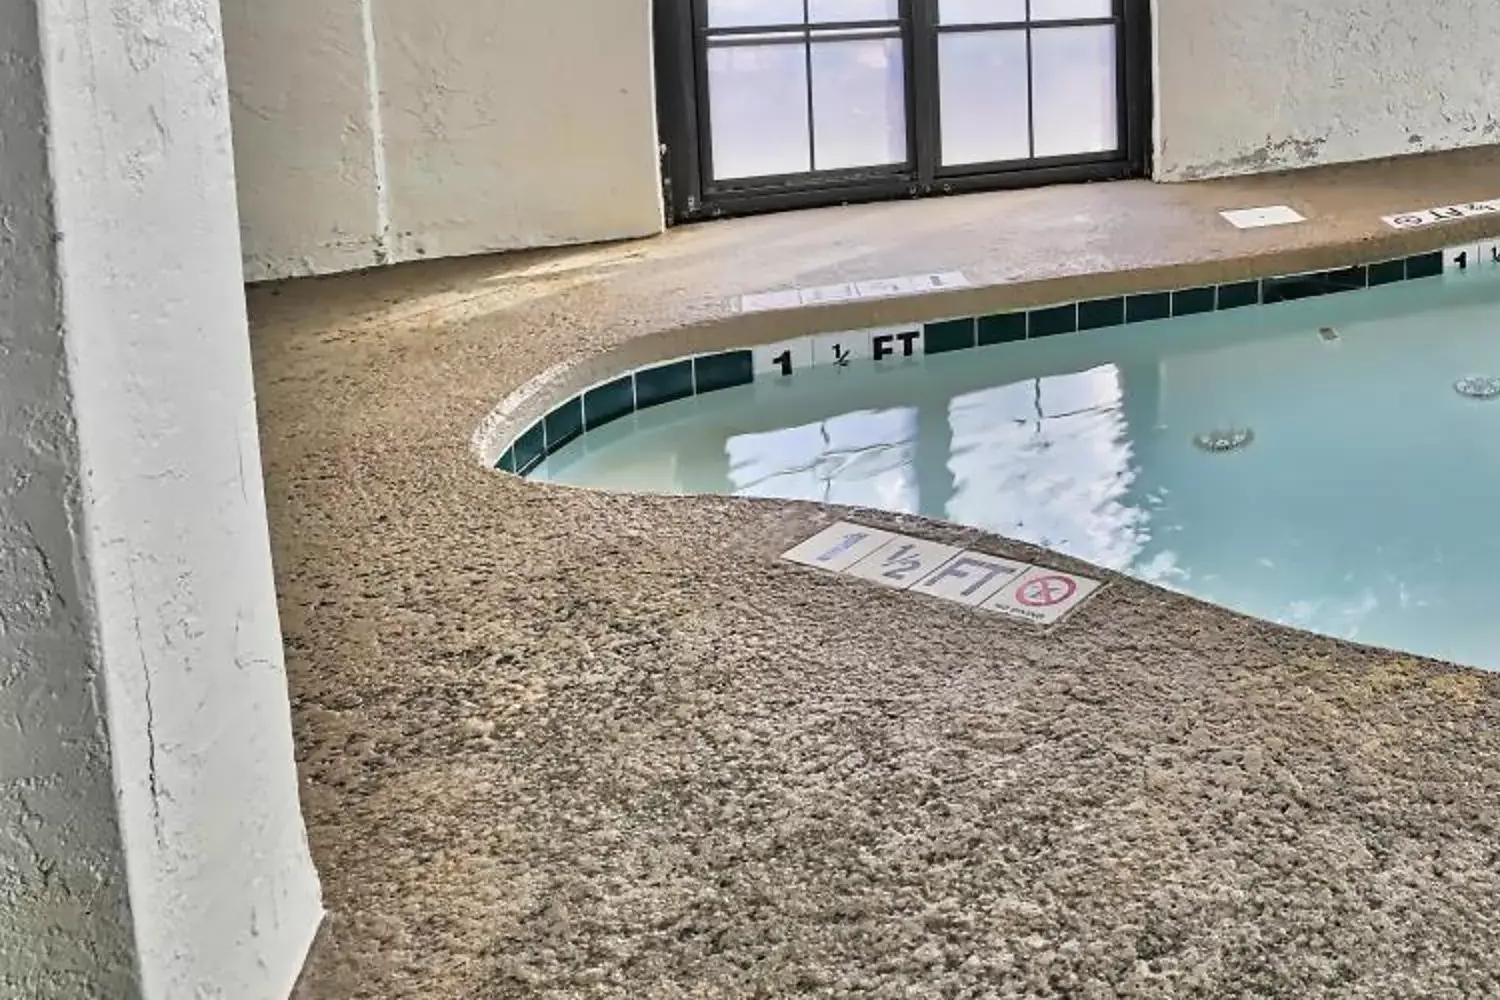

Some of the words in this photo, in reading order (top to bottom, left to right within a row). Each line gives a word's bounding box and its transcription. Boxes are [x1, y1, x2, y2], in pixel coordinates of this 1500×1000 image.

[1454, 251, 1467, 269] 1
[772, 351, 792, 376] 1
[872, 331, 920, 360] FT
[923, 556, 1018, 597] FT
